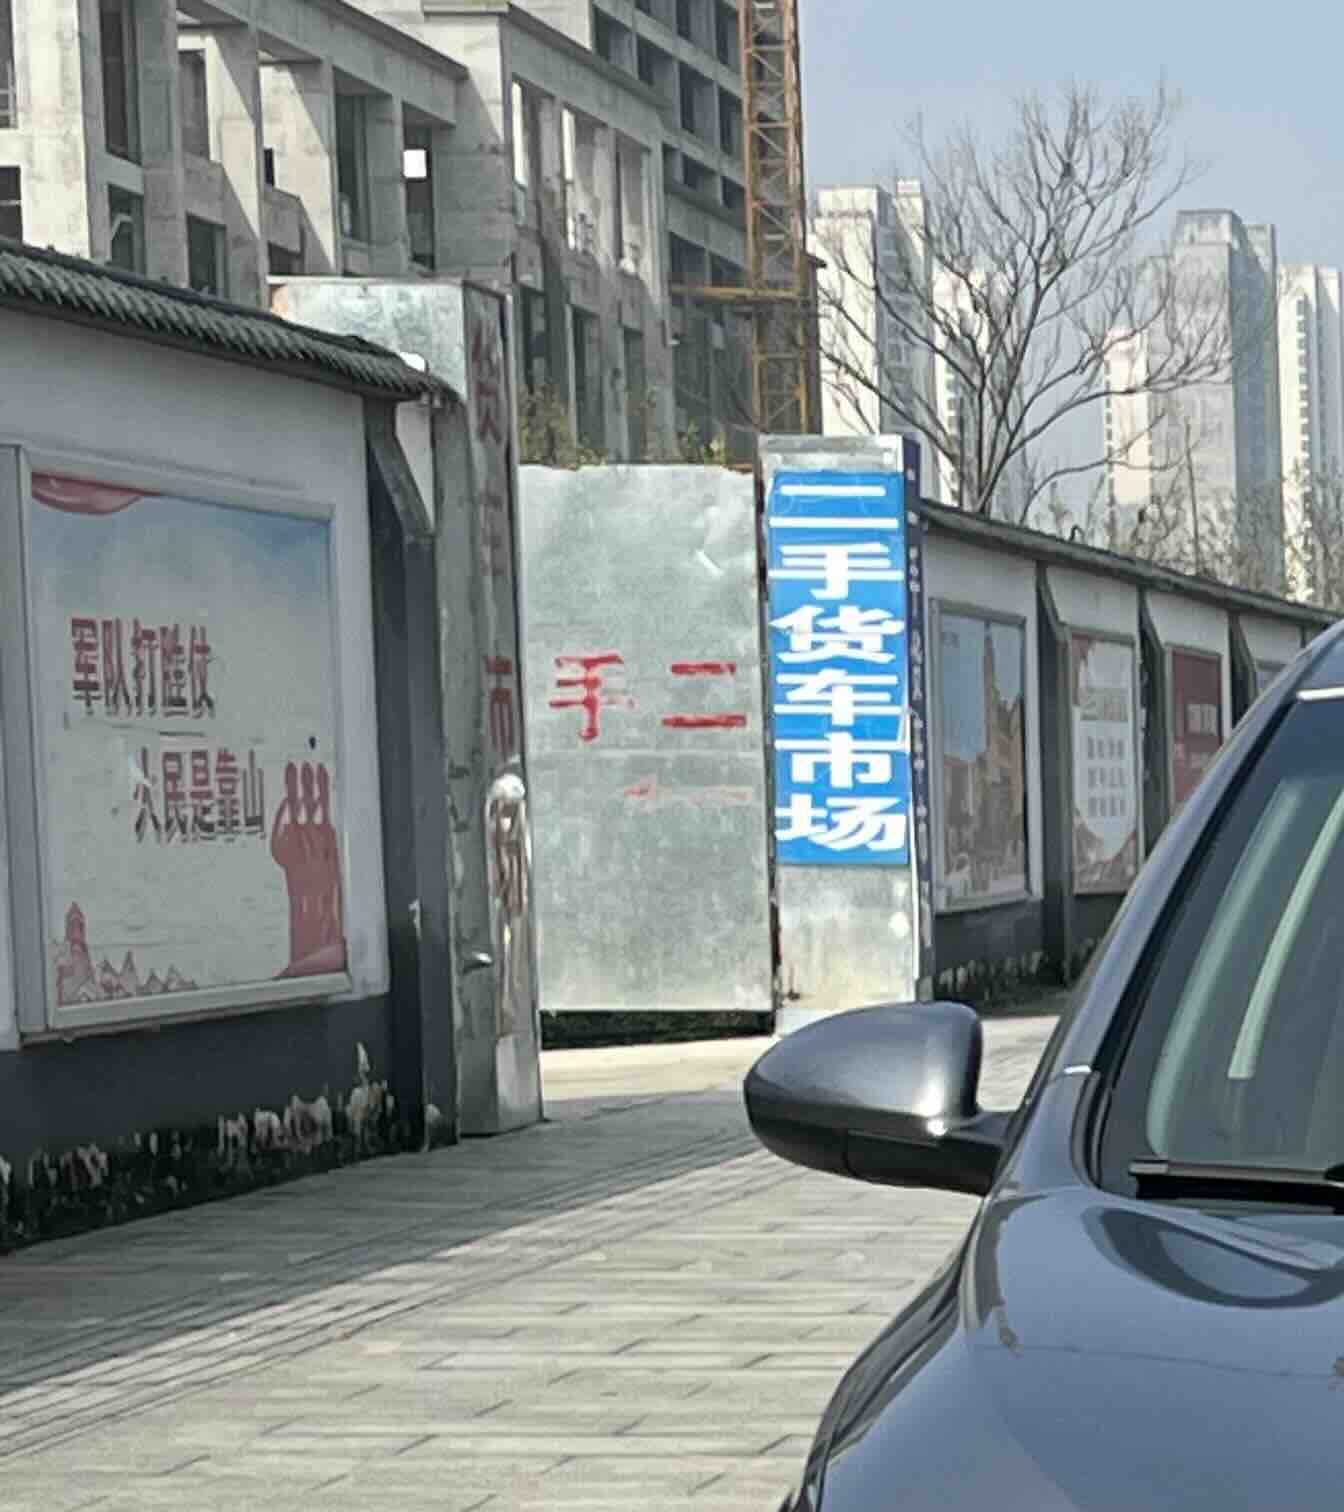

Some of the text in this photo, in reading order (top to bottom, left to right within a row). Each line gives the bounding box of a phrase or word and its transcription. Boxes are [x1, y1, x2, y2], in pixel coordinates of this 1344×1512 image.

[71, 616, 215, 718] 军队打胜仗
[767, 484, 906, 852] 二手货车市场
[133, 746, 266, 843] 人民是靠山
